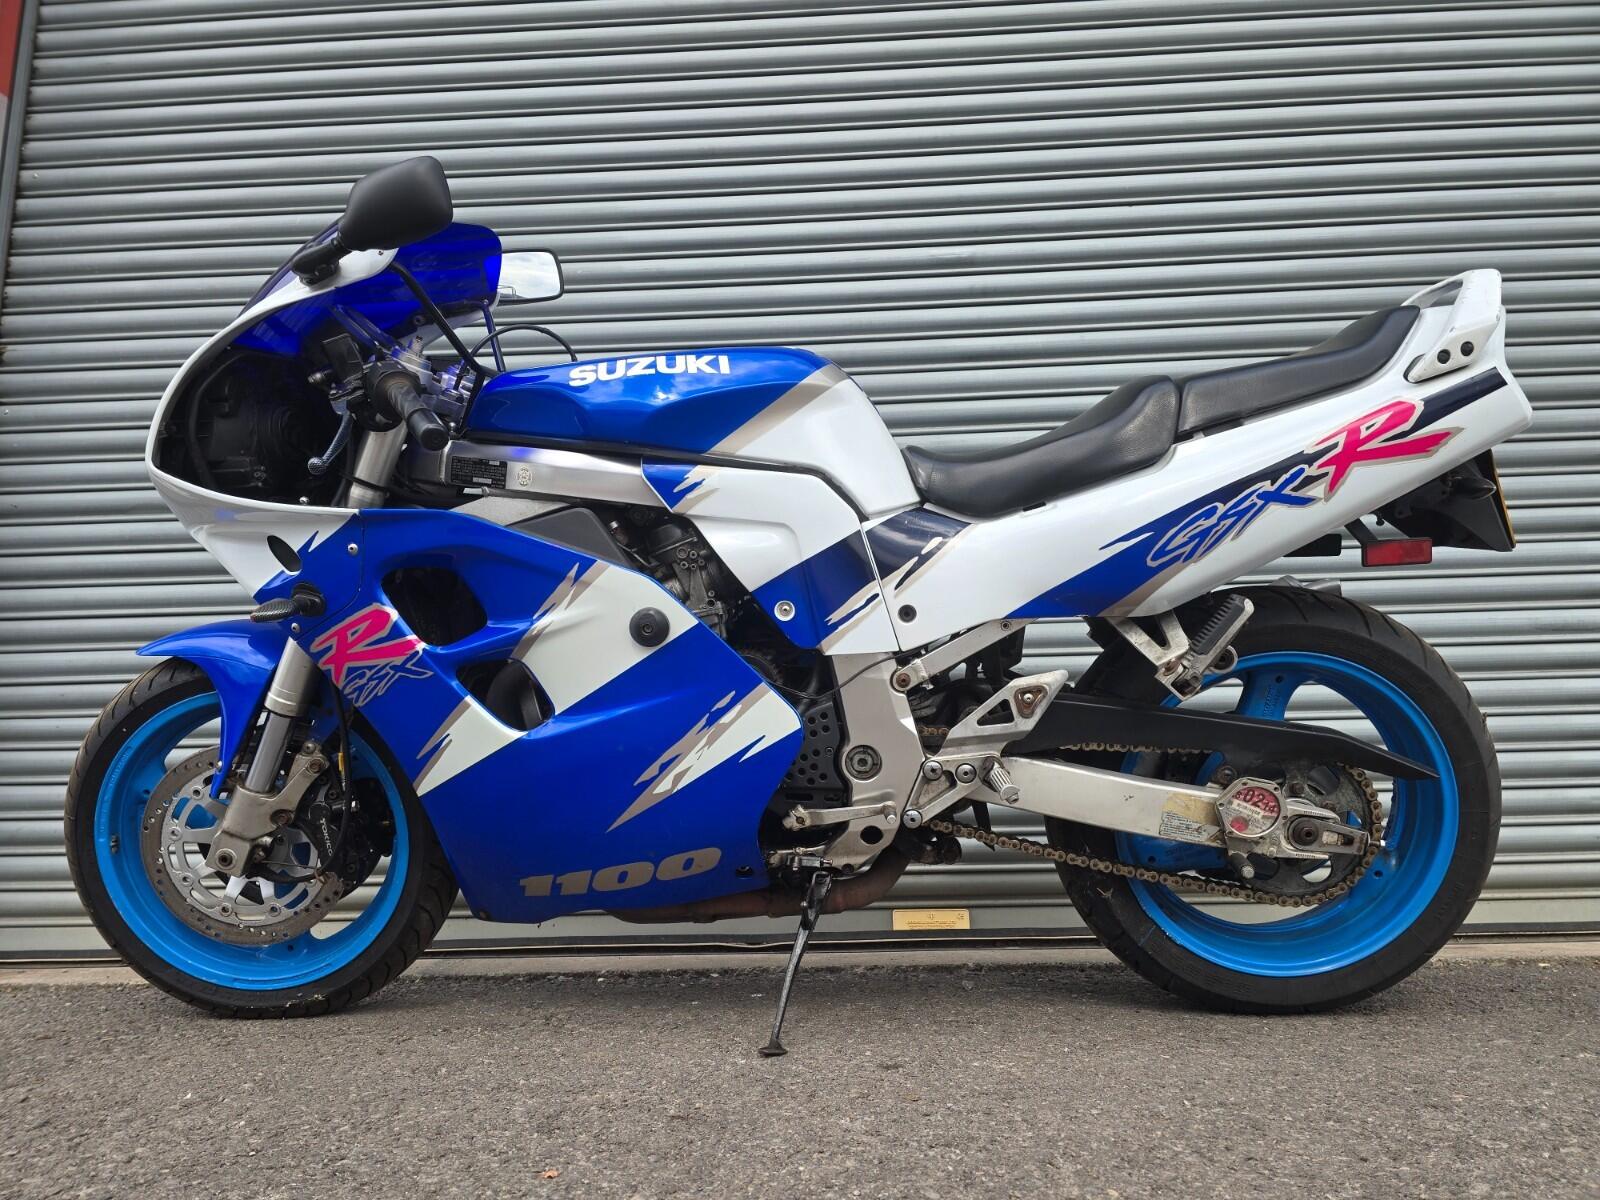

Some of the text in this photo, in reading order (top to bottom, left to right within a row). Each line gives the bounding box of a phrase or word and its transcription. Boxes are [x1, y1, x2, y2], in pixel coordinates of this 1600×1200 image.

[568, 355, 731, 387] SUZUKI
[320, 817, 333, 857] TOKICO
[519, 847, 722, 897] 1100
